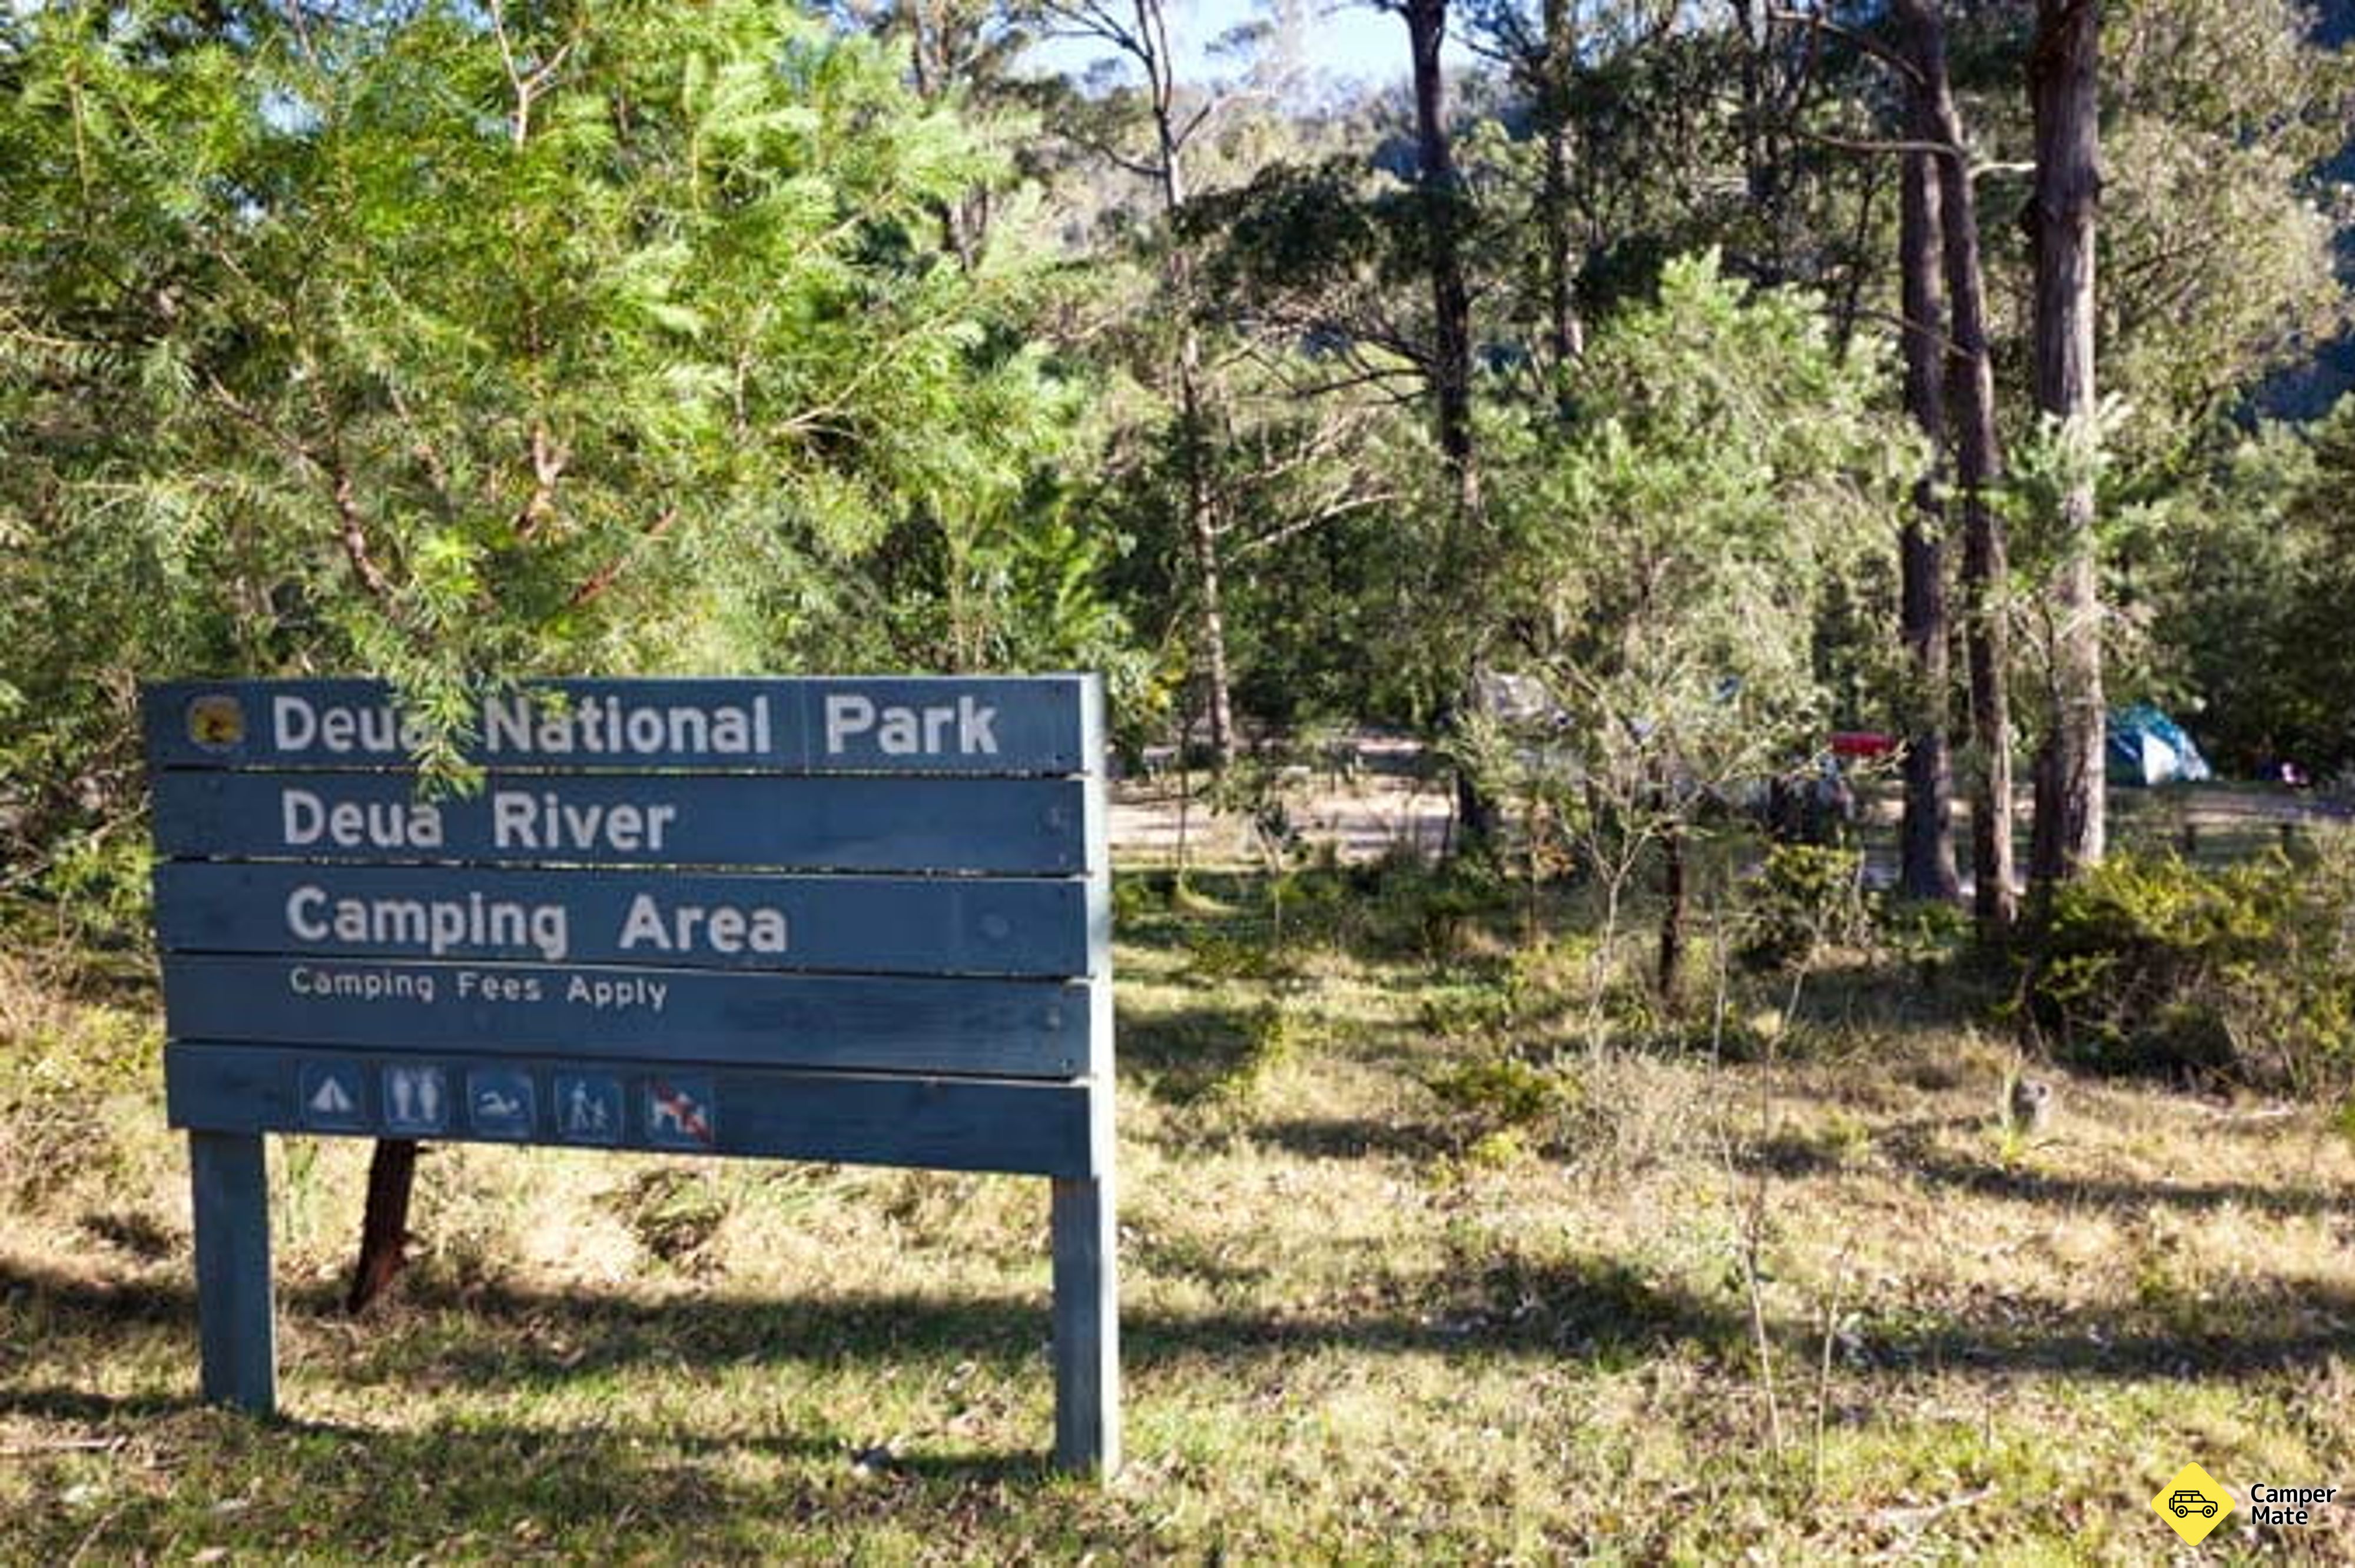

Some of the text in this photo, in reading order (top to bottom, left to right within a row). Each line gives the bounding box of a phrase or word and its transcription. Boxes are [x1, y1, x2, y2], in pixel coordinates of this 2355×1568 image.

[485, 695, 771, 754] National
[825, 695, 999, 755] Park
[281, 789, 676, 851] Deua River
[286, 885, 788, 959] Camping Area
[290, 967, 668, 1010] Camping Fees Apply
